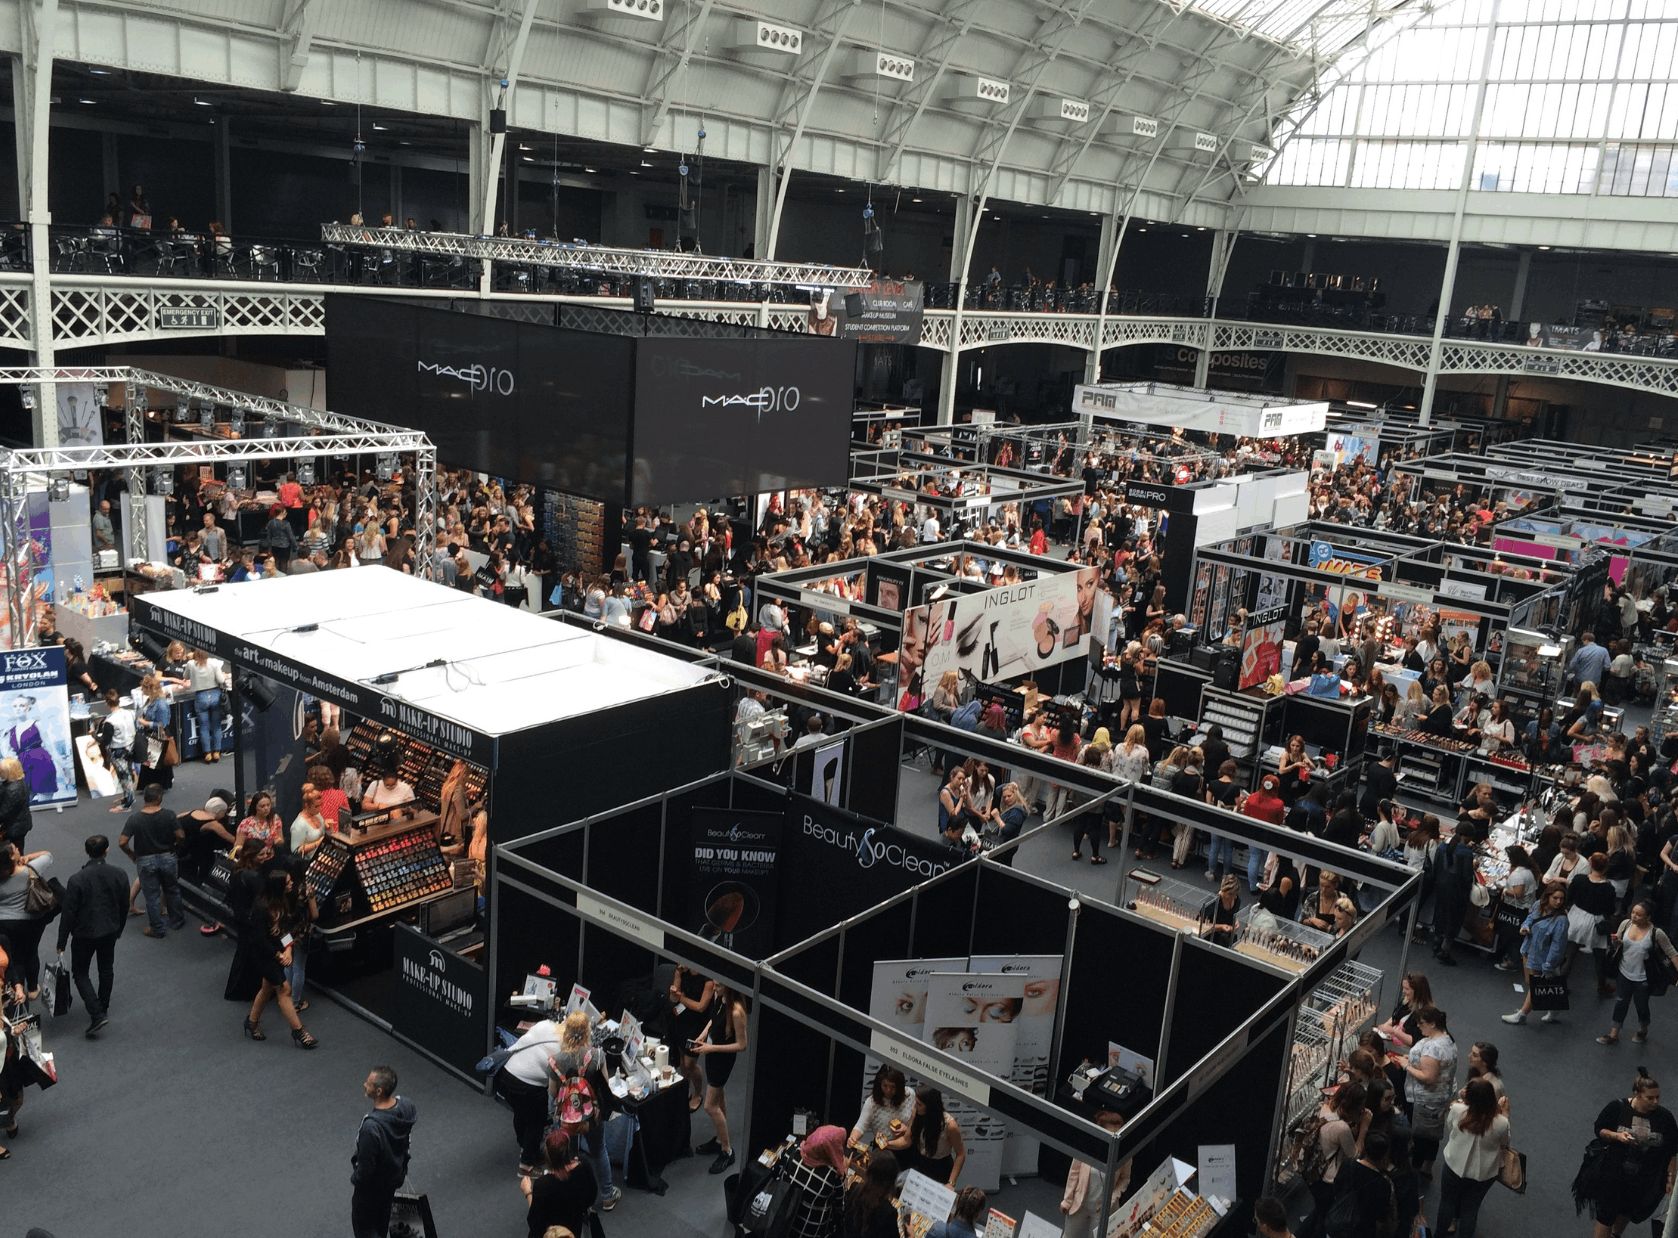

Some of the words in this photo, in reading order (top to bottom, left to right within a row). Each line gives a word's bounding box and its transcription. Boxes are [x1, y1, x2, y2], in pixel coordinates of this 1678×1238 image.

[883, 283, 905, 296] LEVEL
[845, 323, 863, 331] STUDENT
[864, 324, 890, 332] COMPETITION
[1551, 326, 1580, 335] IMATS
[1177, 348, 1268, 370] Coposites
[1516, 474, 1534, 482] BEST
[1146, 490, 1166, 502] PRO
[984, 584, 1036, 610] INGLOT
[1252, 608, 1284, 626] INGLOT
[192, 622, 216, 646] STUDIO
[3, 651, 48, 669] FOX
[6, 670, 58, 681] KRYOLAN
[234, 647, 243, 658] the
[243, 646, 260, 664] art
[265, 657, 300, 682] makeup
[299, 672, 312, 685] from
[312, 676, 358, 704] Amsterdam
[11, 680, 46, 689] LONDON
[398, 704, 439, 735] MAKE-UP
[440, 720, 473, 749] STUDIO
[398, 722, 442, 746] PROFESSIONAL
[444, 741, 472, 757] MAKE-UP
[695, 847, 714, 859] DID
[716, 849, 738, 860] YOU
[741, 850, 776, 862] KNOW
[711, 859, 735, 867] GERMS
[742, 861, 774, 869] BACTERIA
[1498, 912, 1520, 926] IMATS
[402, 956, 441, 991] MAKE-UP
[442, 979, 472, 1010] STUDIO
[1534, 986, 1565, 996] IMATS
[402, 973, 442, 1002] PROFESSIONAL
[445, 998, 471, 1018] MAKE-UP
[902, 1052, 923, 1065] ELDORA
[922, 1061, 938, 1073] FALSE
[938, 1069, 969, 1088] EYELASHES
